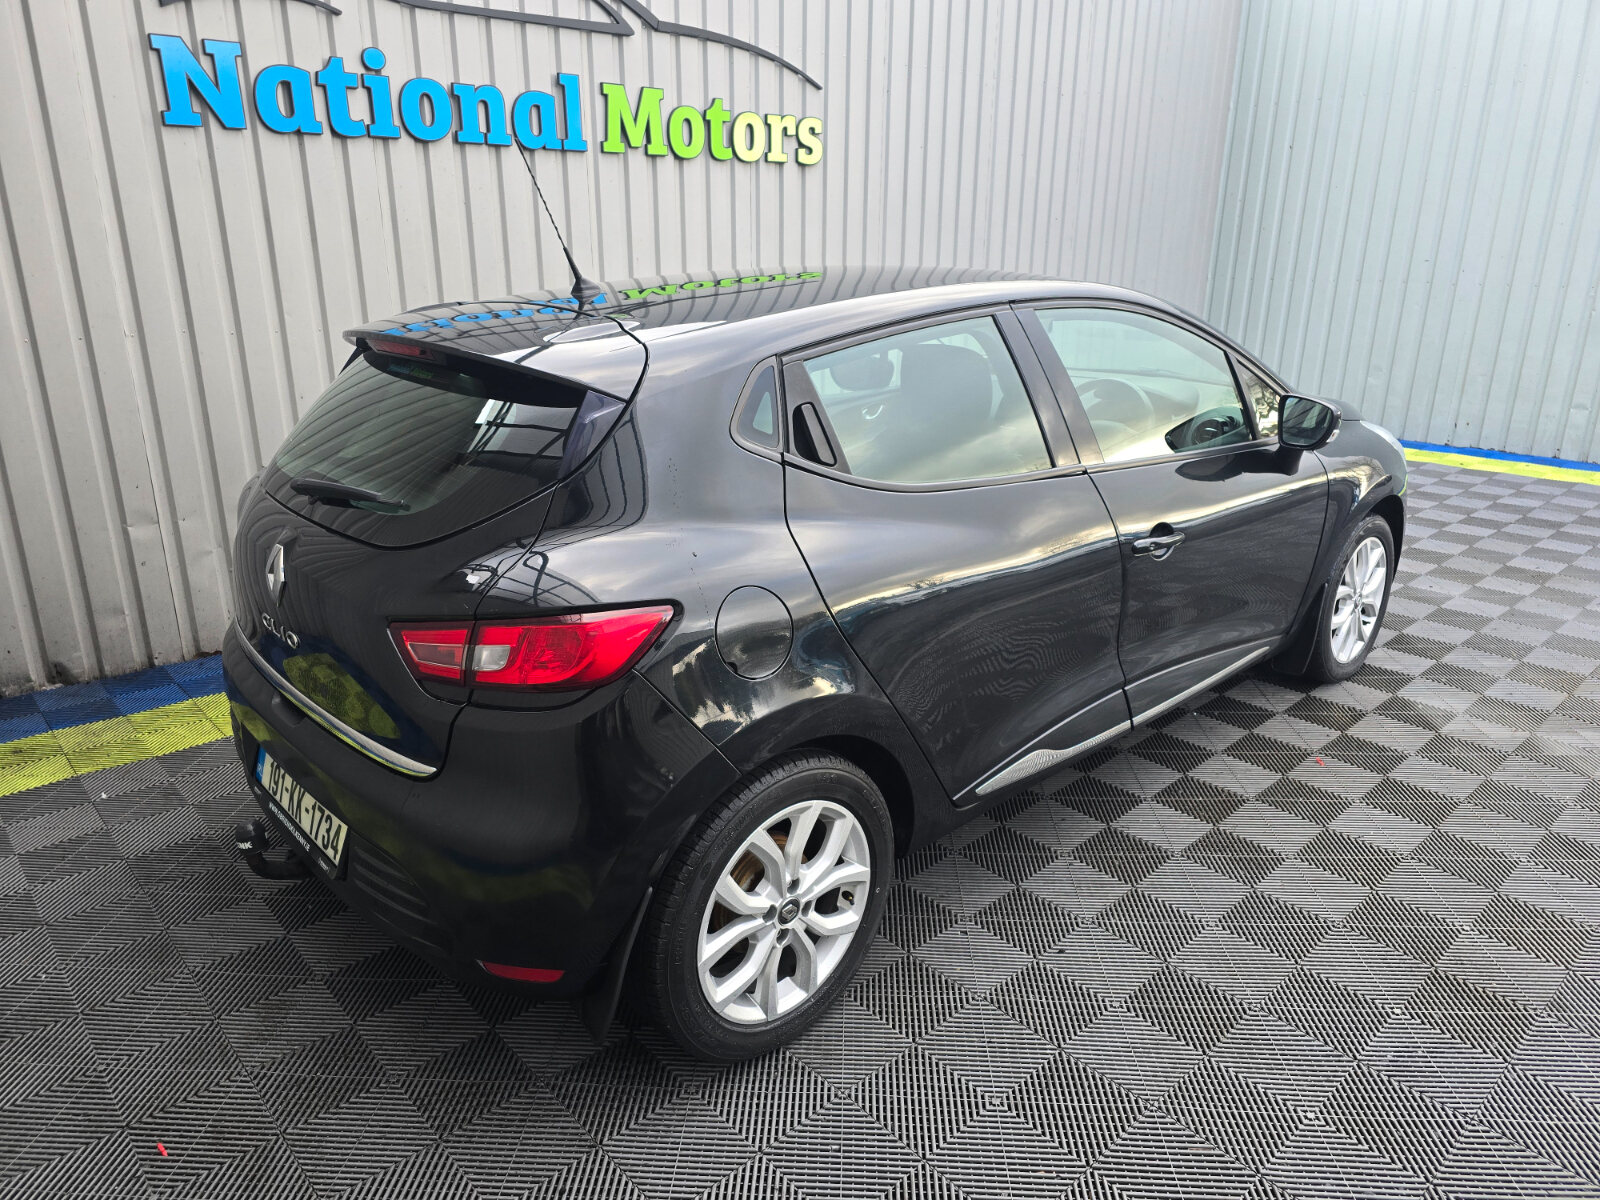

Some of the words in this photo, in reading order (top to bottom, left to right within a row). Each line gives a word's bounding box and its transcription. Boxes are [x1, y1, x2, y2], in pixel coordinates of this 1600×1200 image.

[149, 33, 587, 152] National
[601, 82, 823, 166] Motors
[261, 612, 299, 650] CLIO
[268, 760, 343, 862] 191-KK-1734
